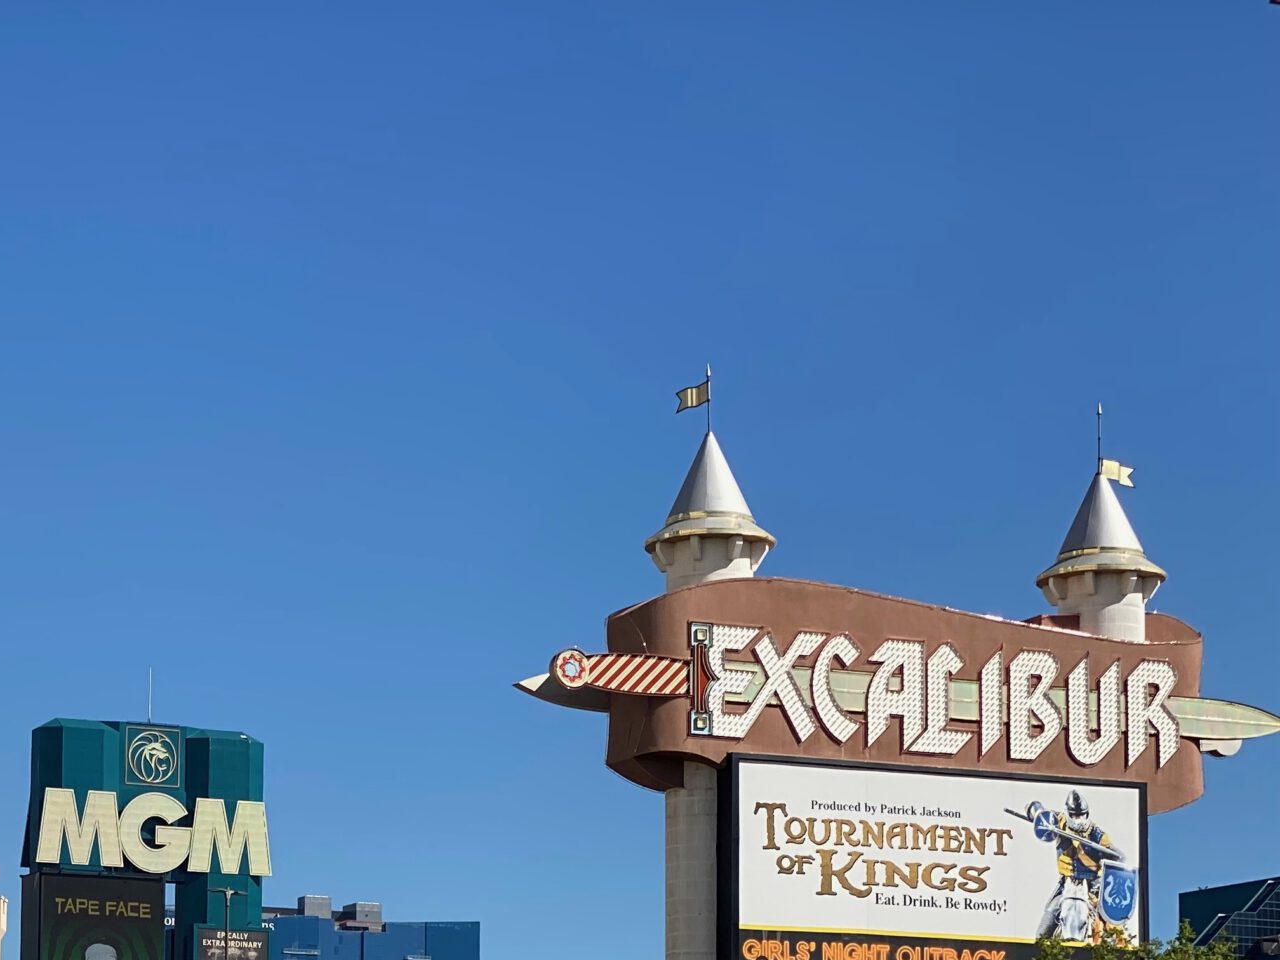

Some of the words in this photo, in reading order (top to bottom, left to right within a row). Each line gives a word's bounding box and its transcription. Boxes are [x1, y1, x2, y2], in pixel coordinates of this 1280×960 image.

[708, 624, 1182, 771] EXCALIBUR
[811, 800, 861, 813] Produced
[864, 802, 877, 815] by
[880, 804, 917, 816] Patrick
[919, 806, 961, 819] Jackson
[36, 787, 272, 876] MGM
[753, 802, 1014, 856] TOURNAMENT
[815, 849, 991, 898] KINGS
[55, 898, 100, 916] TAPE
[105, 901, 152, 918] FACE
[874, 893, 900, 906] Eat.
[902, 894, 942, 909] Drink.
[945, 897, 961, 910] Be
[964, 898, 1007, 914] Rowdy!
[217, 931, 248, 940] EPCALLY
